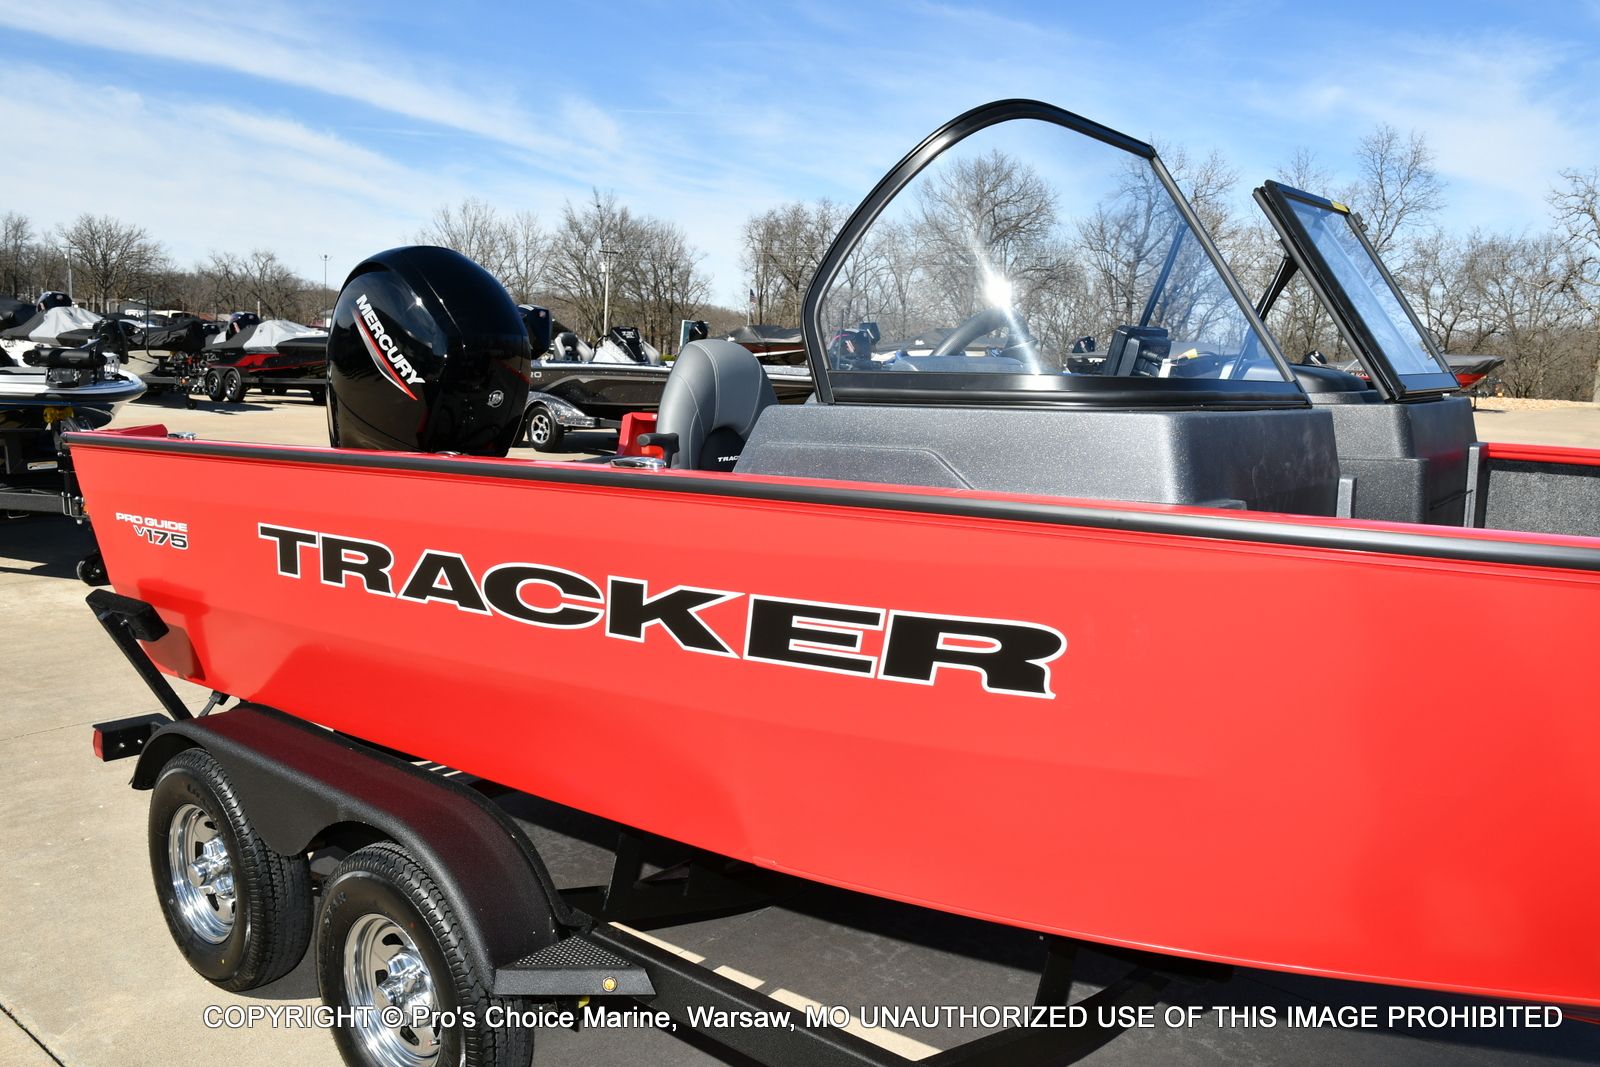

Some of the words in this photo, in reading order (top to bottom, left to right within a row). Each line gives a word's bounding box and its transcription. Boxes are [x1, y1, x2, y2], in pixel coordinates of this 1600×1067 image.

[355, 293, 426, 386] MERCURY
[717, 455, 740, 463] TRAC
[116, 512, 143, 525] PRO
[144, 517, 188, 532] GUIDE
[258, 522, 1068, 700] TRACKER
